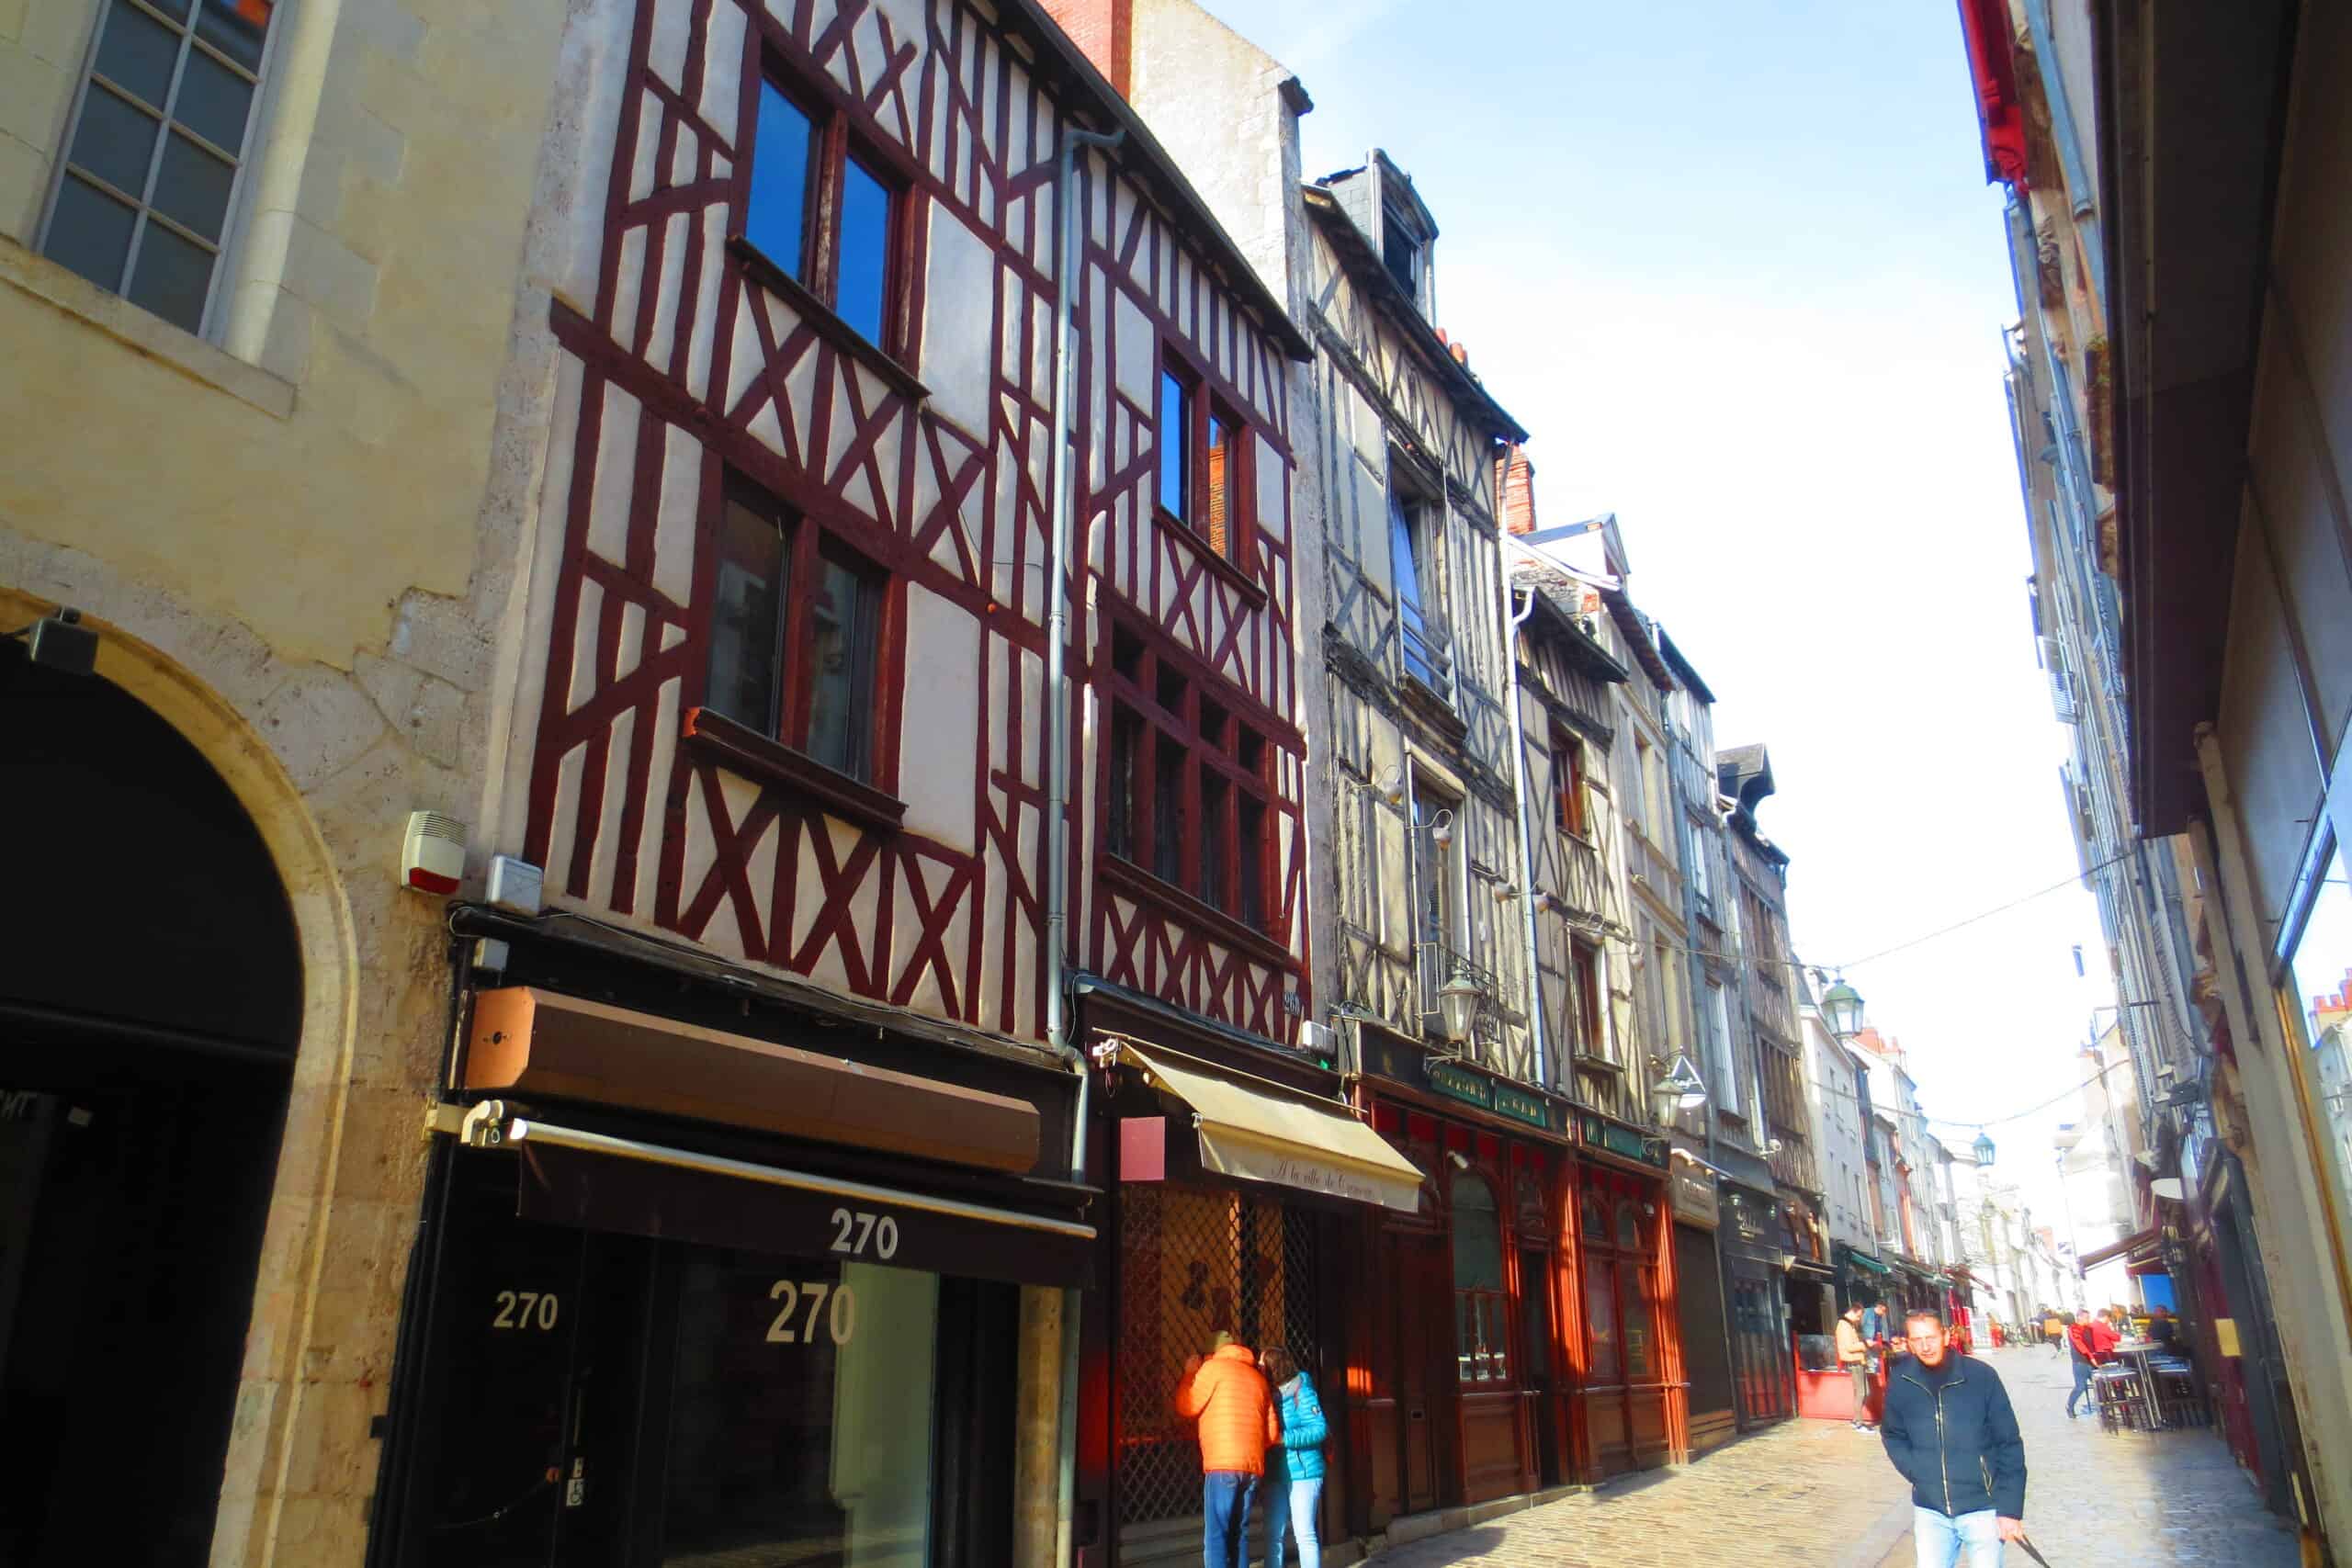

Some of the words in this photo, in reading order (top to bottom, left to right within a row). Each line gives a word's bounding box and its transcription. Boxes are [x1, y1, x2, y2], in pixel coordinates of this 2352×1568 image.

[830, 1208, 899, 1259] 270
[492, 1291, 559, 1330] 270
[765, 1280, 855, 1346] 270
